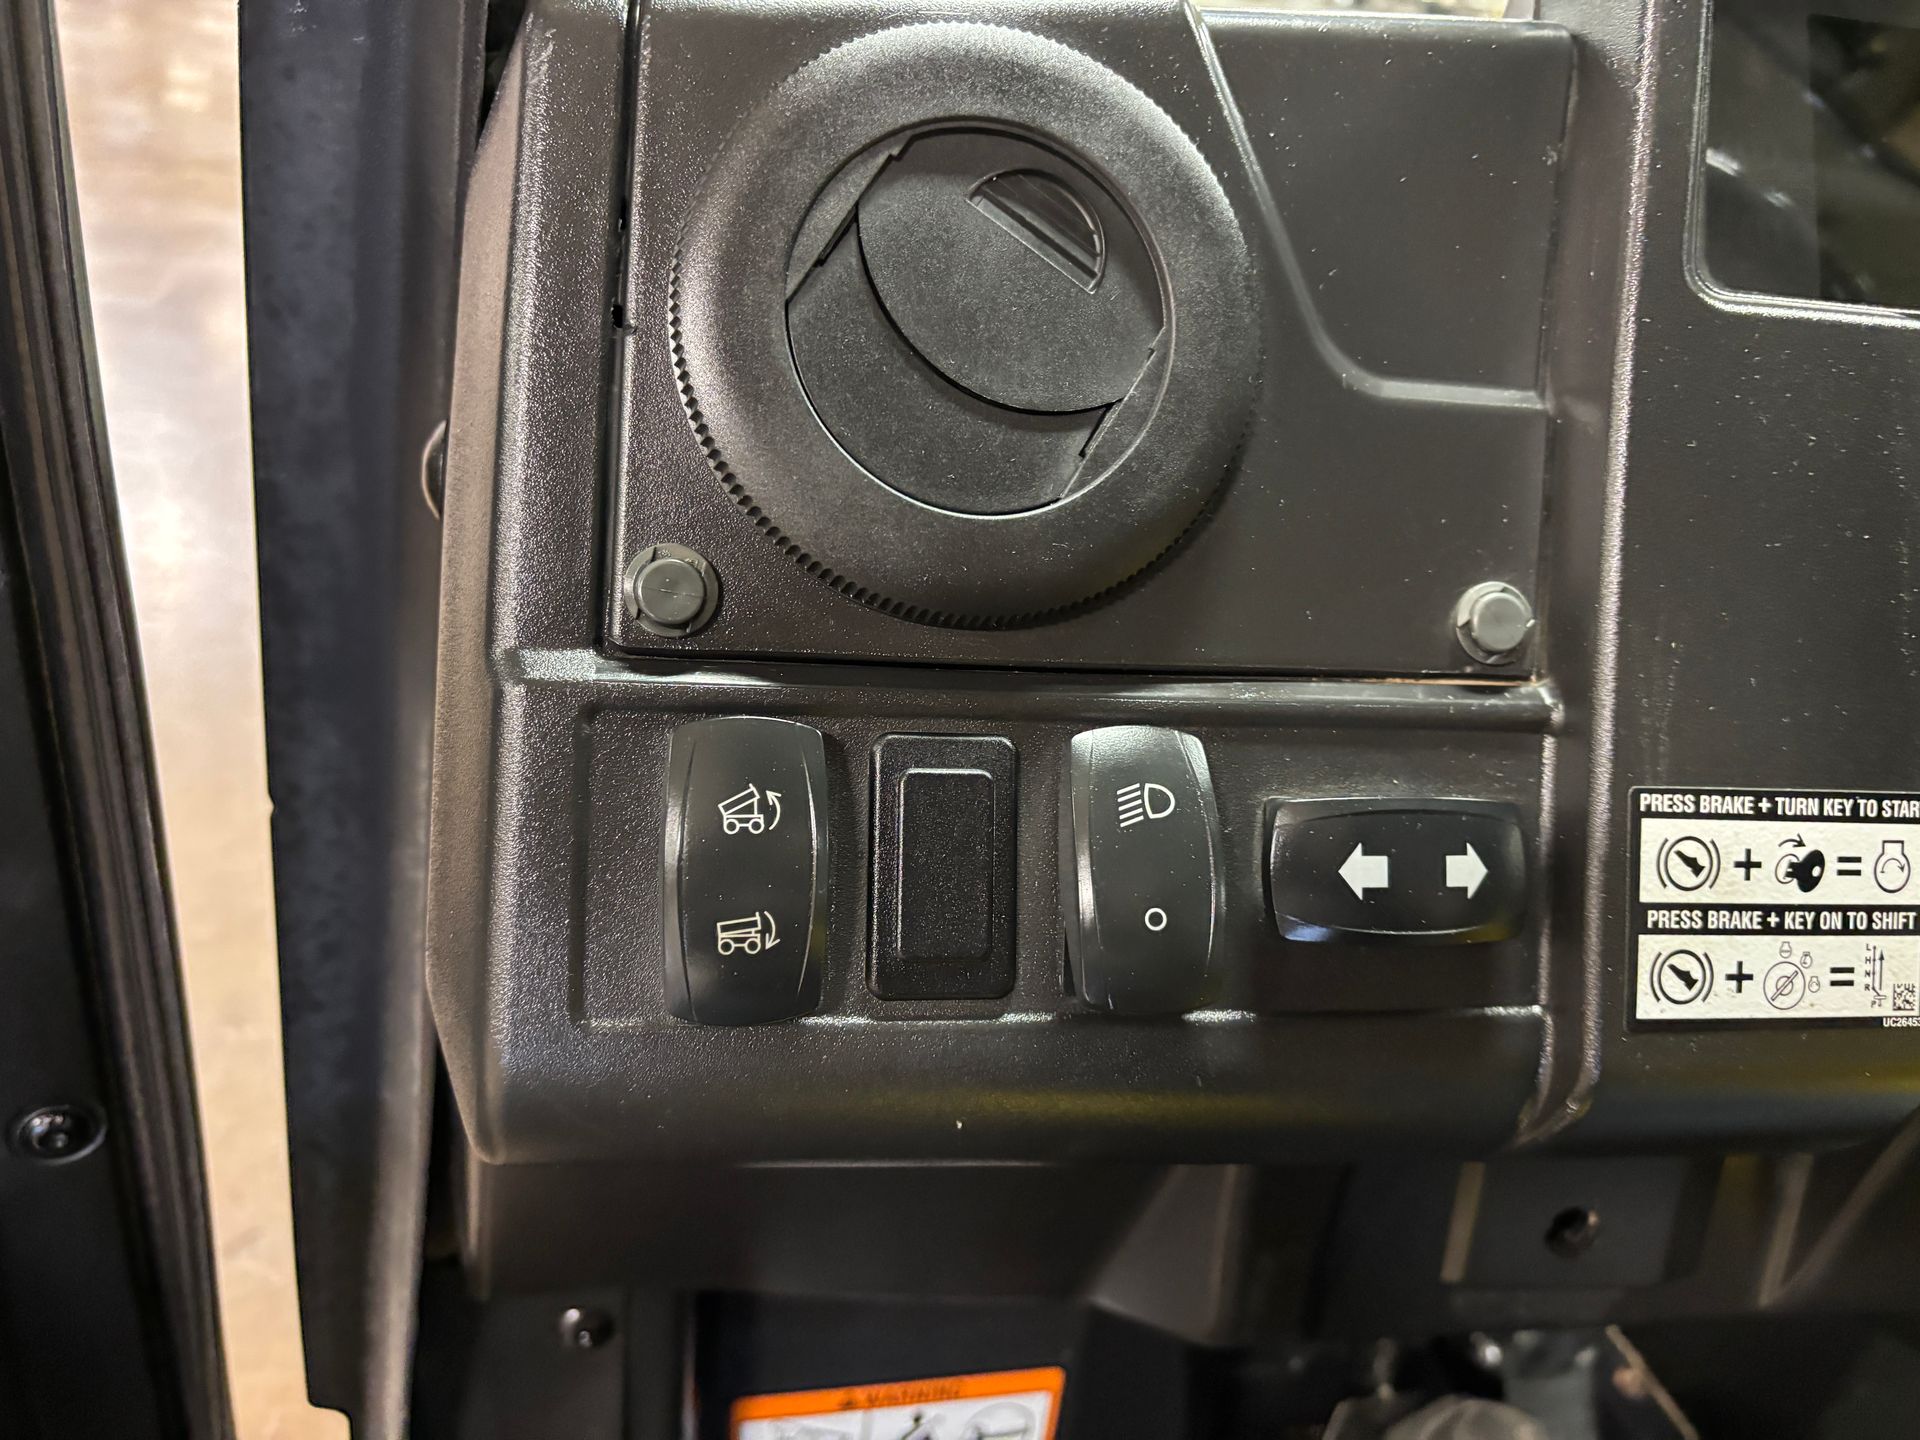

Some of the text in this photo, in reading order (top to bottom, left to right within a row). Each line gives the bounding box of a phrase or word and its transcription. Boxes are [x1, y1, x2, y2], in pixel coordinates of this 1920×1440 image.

[1639, 793, 1695, 814] PRESS
[1700, 795, 1755, 815] BRAKE
[1775, 797, 1818, 816] TURN
[1823, 798, 1854, 817] KEY
[1857, 799, 1878, 817] TO
[1882, 800, 1920, 818] STAR
[1647, 910, 1702, 929] PRESS
[1707, 911, 1762, 929] BRAKE
[1784, 912, 1815, 930] KEY
[1820, 912, 1841, 930] ON
[1848, 912, 1867, 930] TO
[1872, 912, 1916, 930] SHIFT
